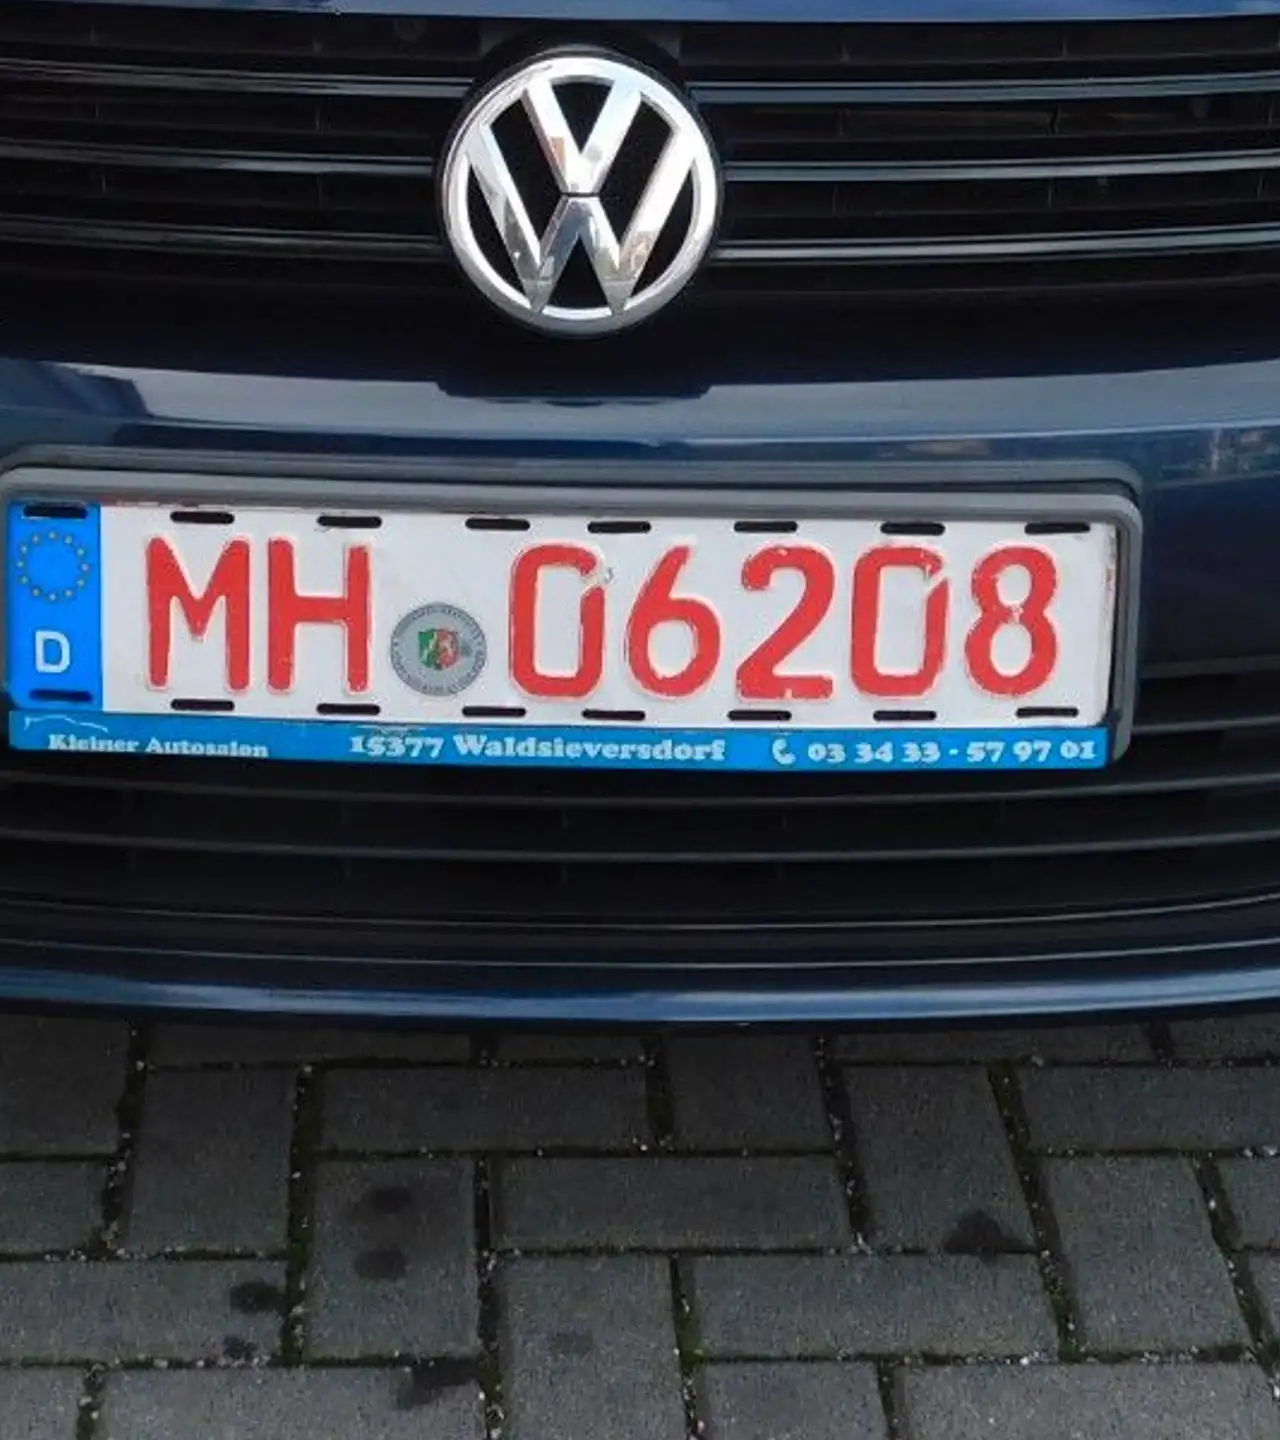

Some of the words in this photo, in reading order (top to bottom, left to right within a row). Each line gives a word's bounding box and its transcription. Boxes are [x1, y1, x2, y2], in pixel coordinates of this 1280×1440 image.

[462, 68, 702, 318] VW
[146, 536, 370, 692] MH
[508, 542, 1060, 698] 06208
[35, 630, 70, 673] D
[48, 734, 138, 752] Kleiner
[145, 737, 268, 757] Autosalon
[349, 735, 443, 757] 15377
[453, 734, 726, 760] Waldsieversdorf
[807, 741, 845, 762] 03
[854, 741, 893, 763] 34
[902, 741, 940, 763] 33
[966, 741, 1004, 763] 57
[1013, 741, 1051, 763] 97
[1060, 740, 1095, 759] 01
